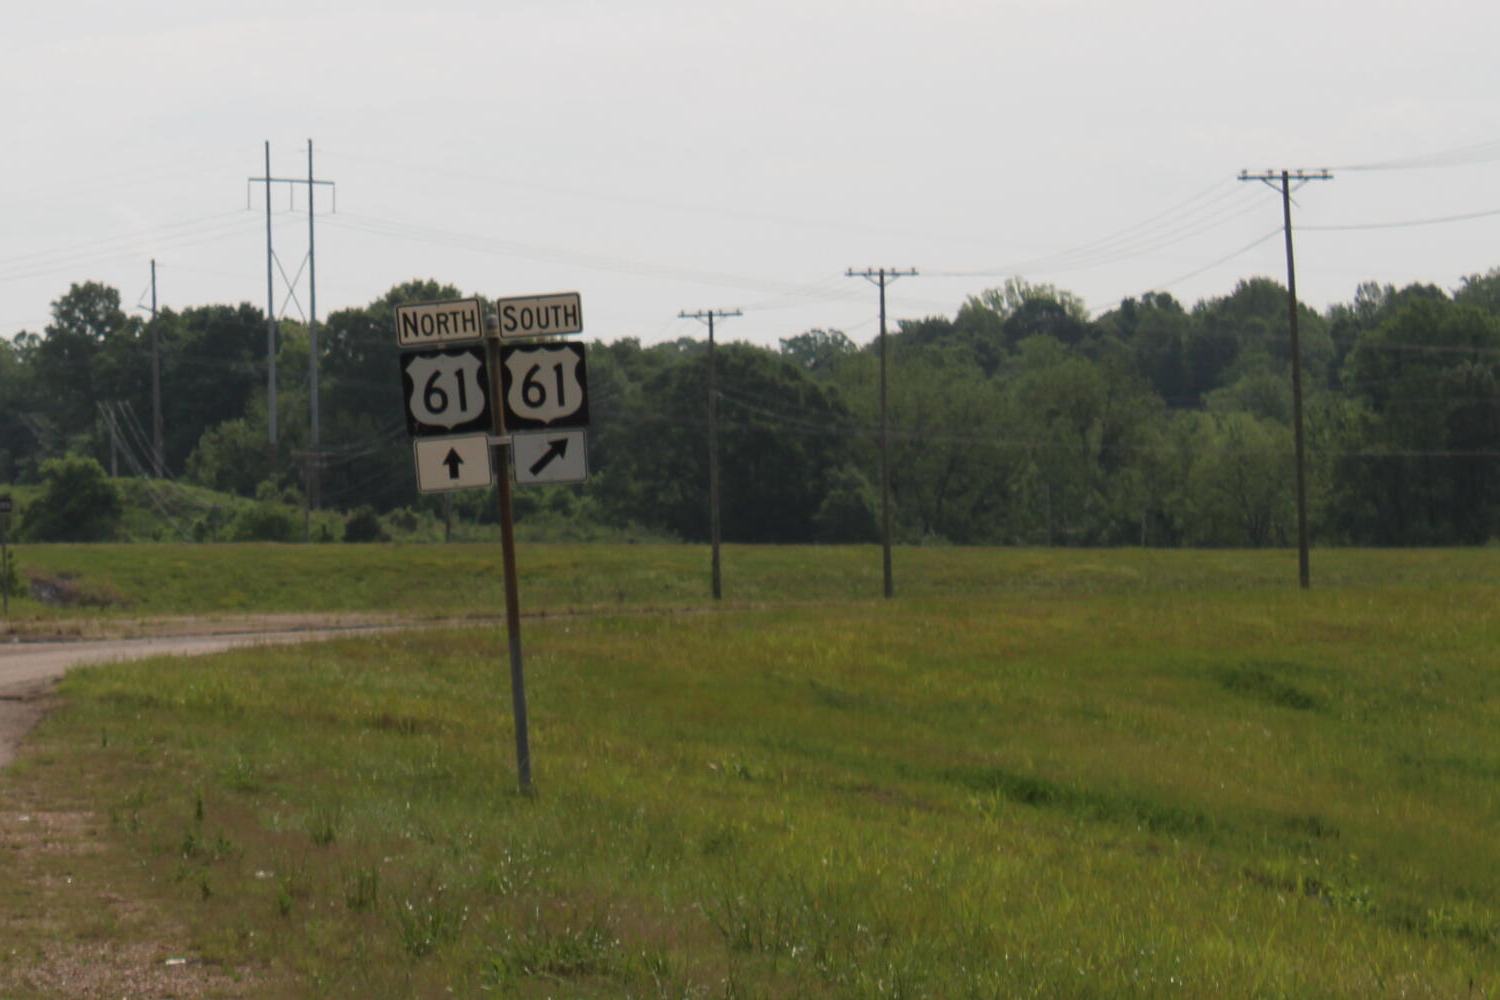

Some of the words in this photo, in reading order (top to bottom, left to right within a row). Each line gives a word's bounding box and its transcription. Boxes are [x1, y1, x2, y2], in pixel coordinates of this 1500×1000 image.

[402, 310, 476, 338] NORTH
[503, 304, 577, 332] SOUTH
[424, 368, 467, 415] 61
[522, 362, 564, 409] 61
